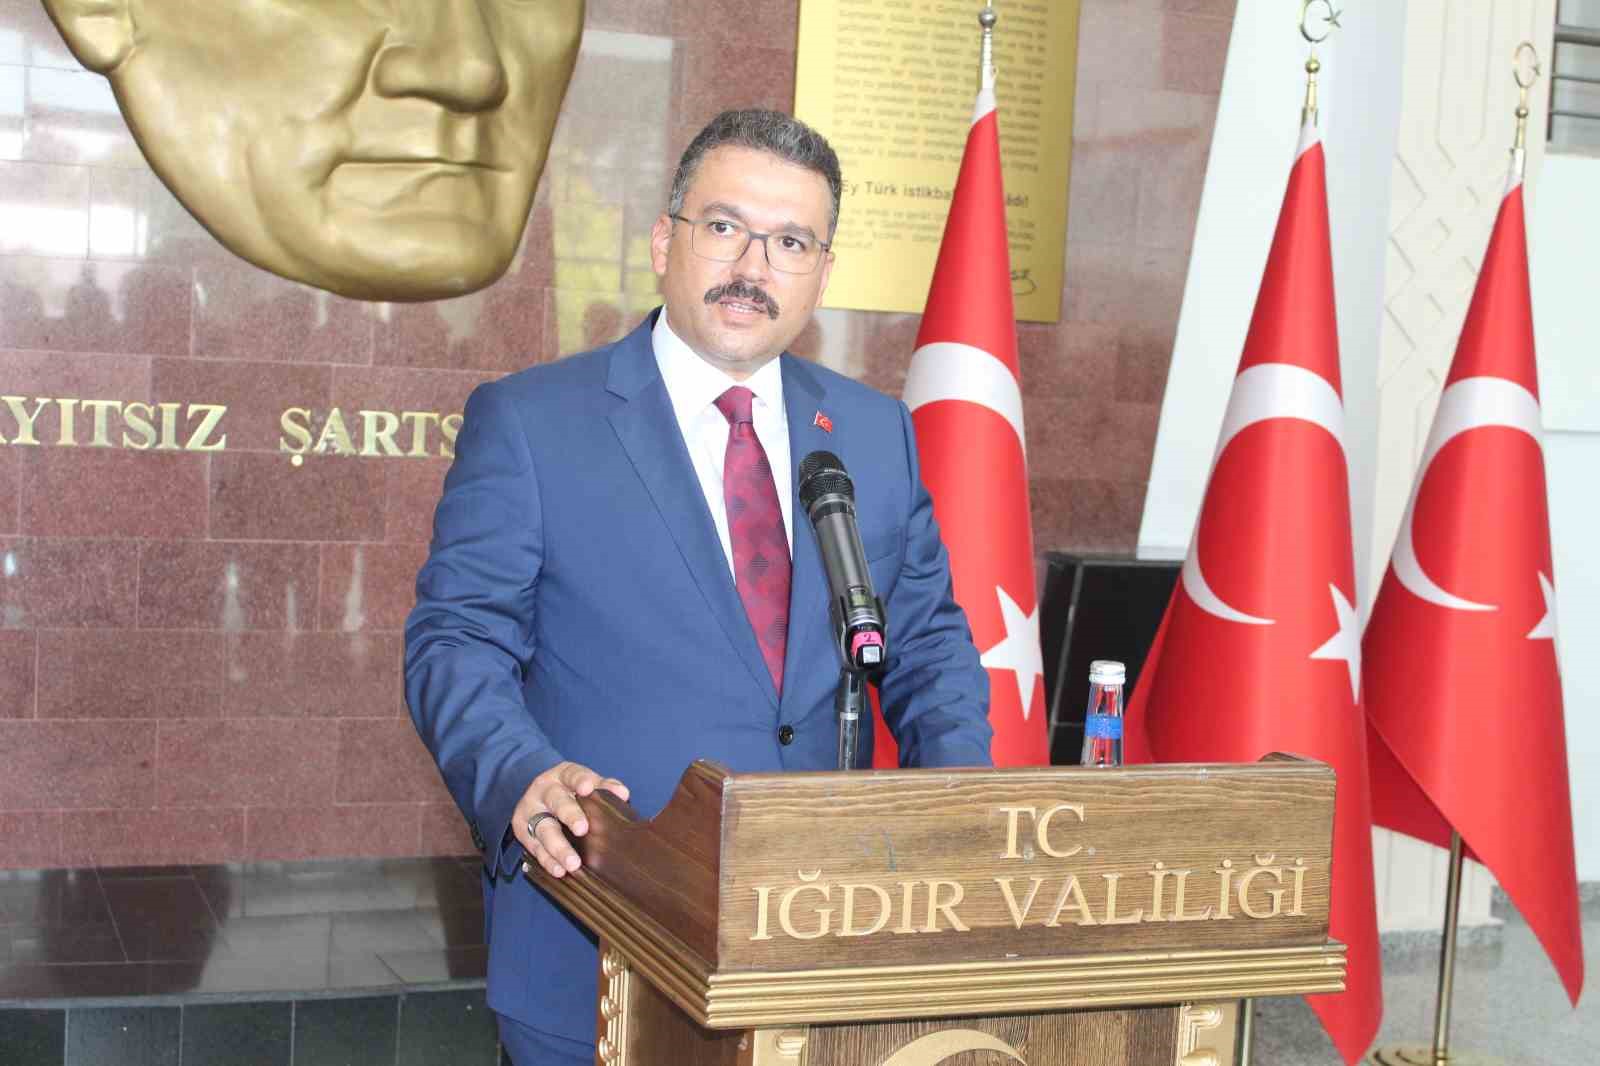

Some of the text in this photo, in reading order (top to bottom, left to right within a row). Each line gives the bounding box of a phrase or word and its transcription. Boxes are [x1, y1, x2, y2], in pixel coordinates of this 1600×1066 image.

[841, 179, 858, 196] Ey
[864, 181, 897, 196] Türk
[0, 395, 228, 452] YITSIZ
[749, 853, 1309, 942] IĞDIR VALİLİĞİ
